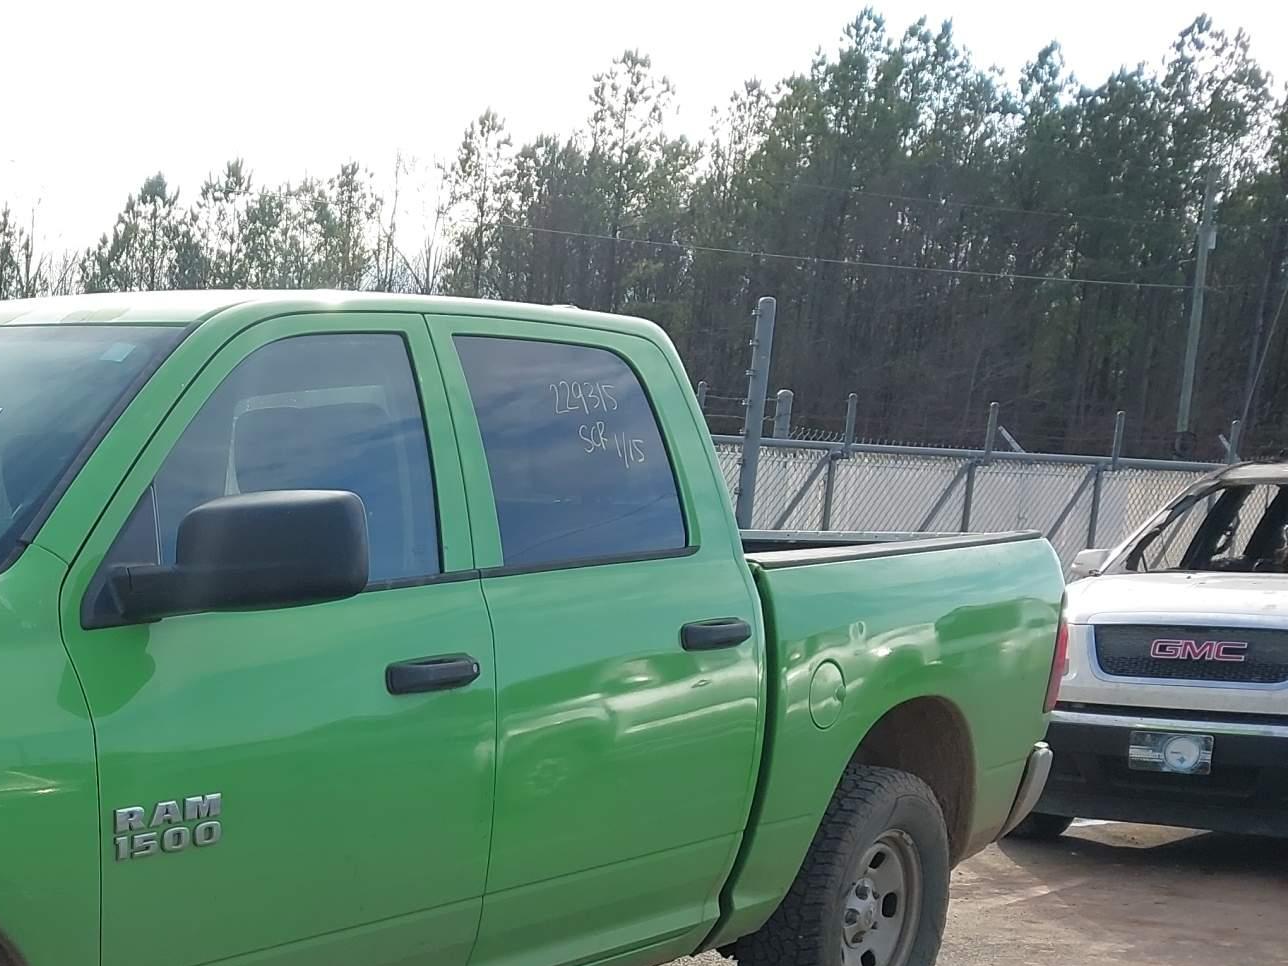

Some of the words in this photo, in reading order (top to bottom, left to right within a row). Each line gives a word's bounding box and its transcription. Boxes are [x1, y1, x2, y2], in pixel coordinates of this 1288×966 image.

[1151, 639, 1248, 662] GMC
[113, 792, 222, 833] RAM
[114, 820, 222, 861] 1500
